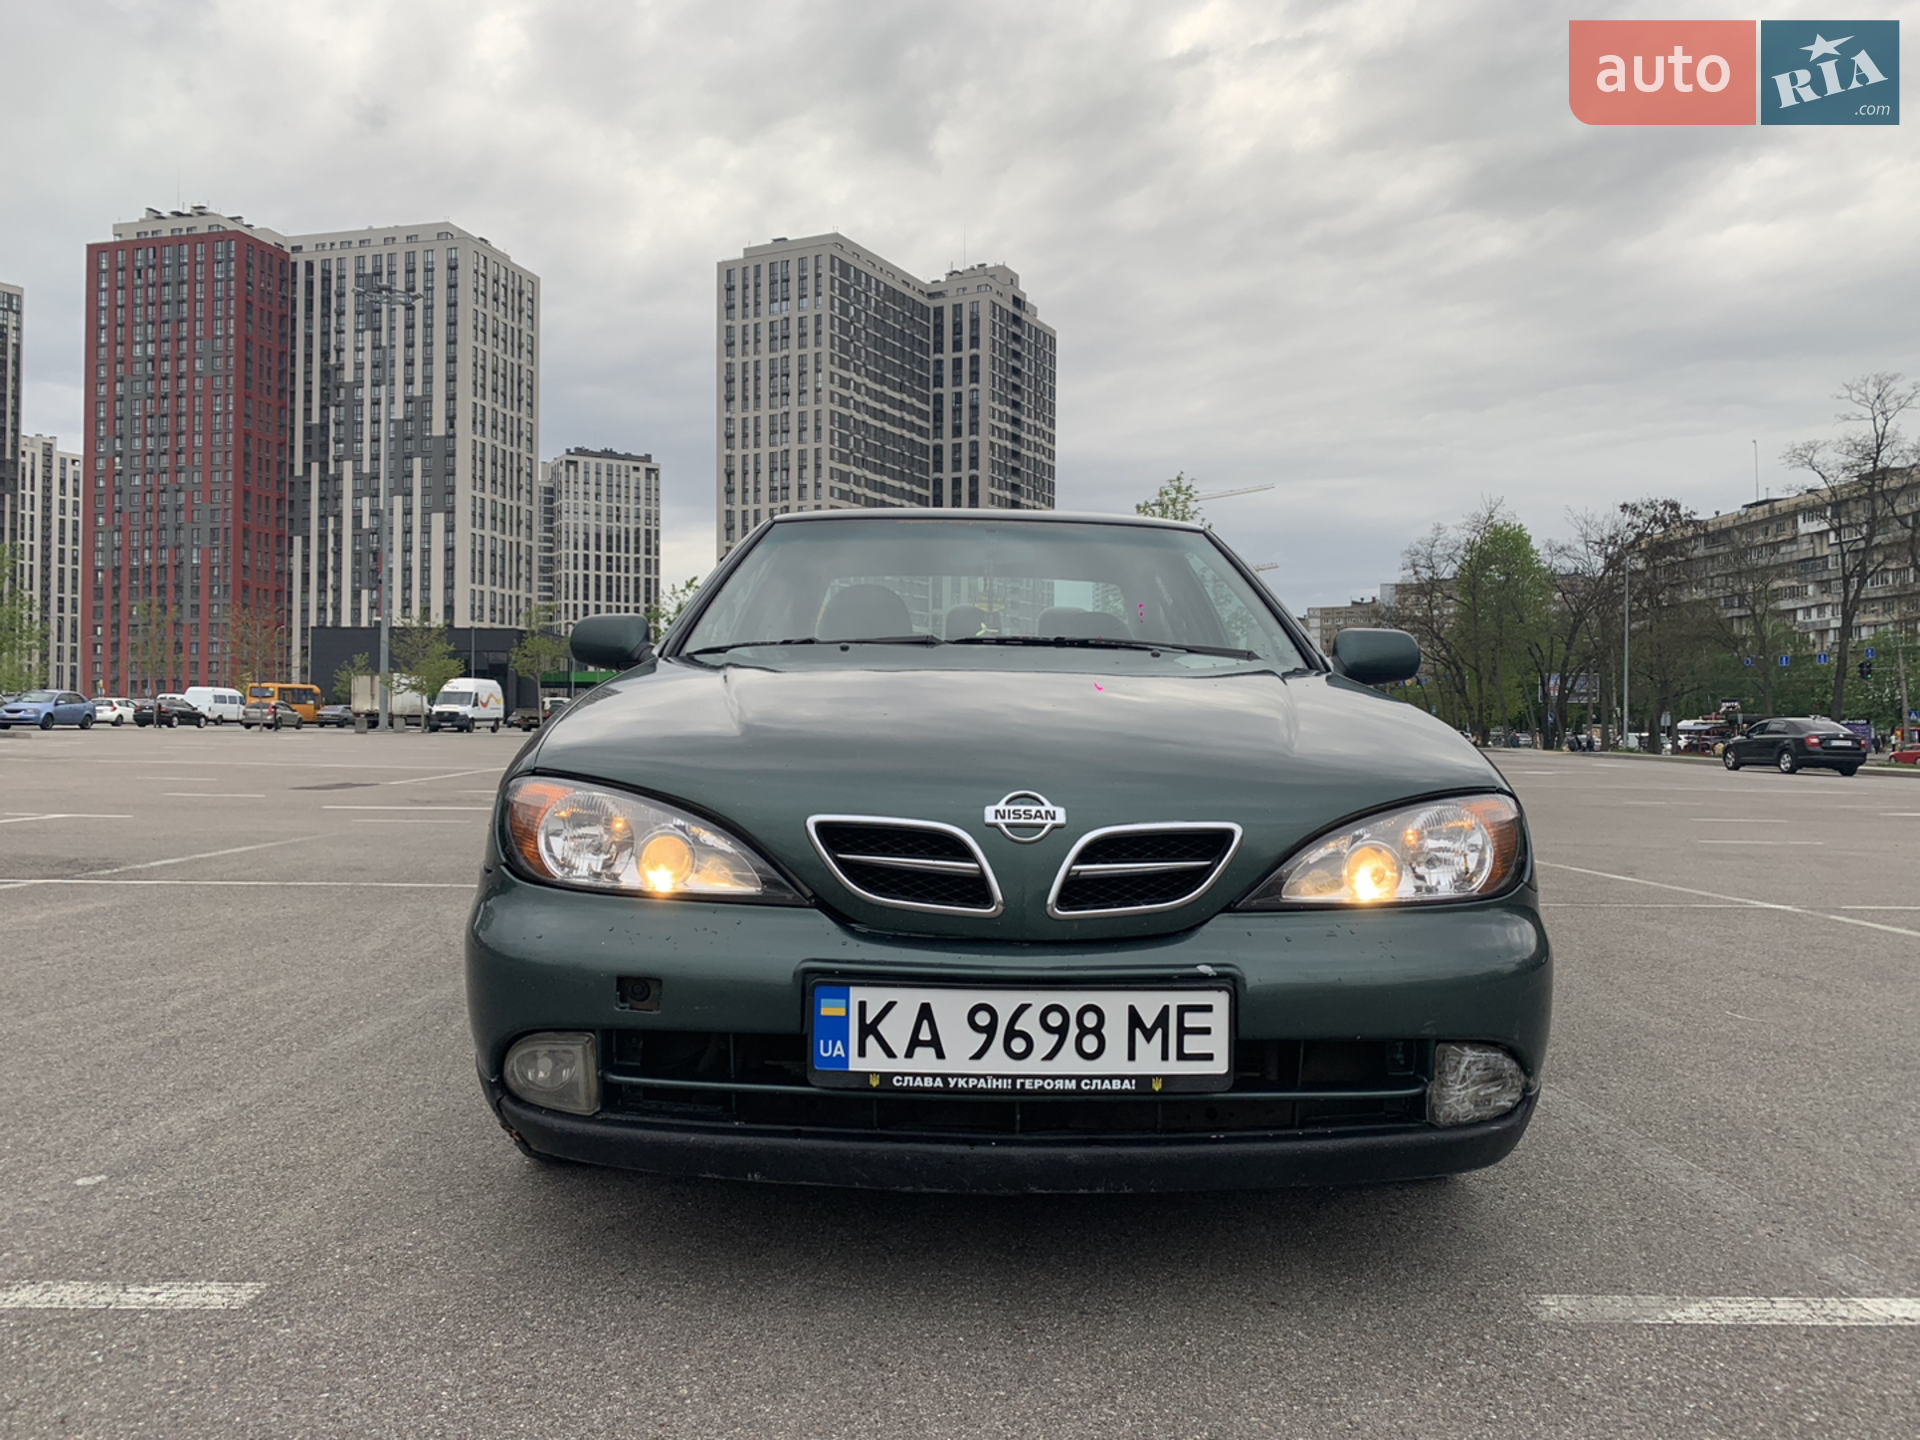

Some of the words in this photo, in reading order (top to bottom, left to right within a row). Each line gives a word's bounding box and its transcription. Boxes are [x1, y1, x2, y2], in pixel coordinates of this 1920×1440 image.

[994, 808, 1057, 821] NISSAN
[857, 1000, 946, 1060] KA
[966, 1002, 1107, 1062] 9698
[1127, 1004, 1215, 1062] ME
[819, 1039, 846, 1059] UA
[892, 1075, 944, 1088] СЛАВА
[947, 1075, 1012, 1089] УКРАЇНІ!
[1016, 1078, 1077, 1090] ГЕРОЯМ
[1080, 1078, 1137, 1090] СЛАВА!
